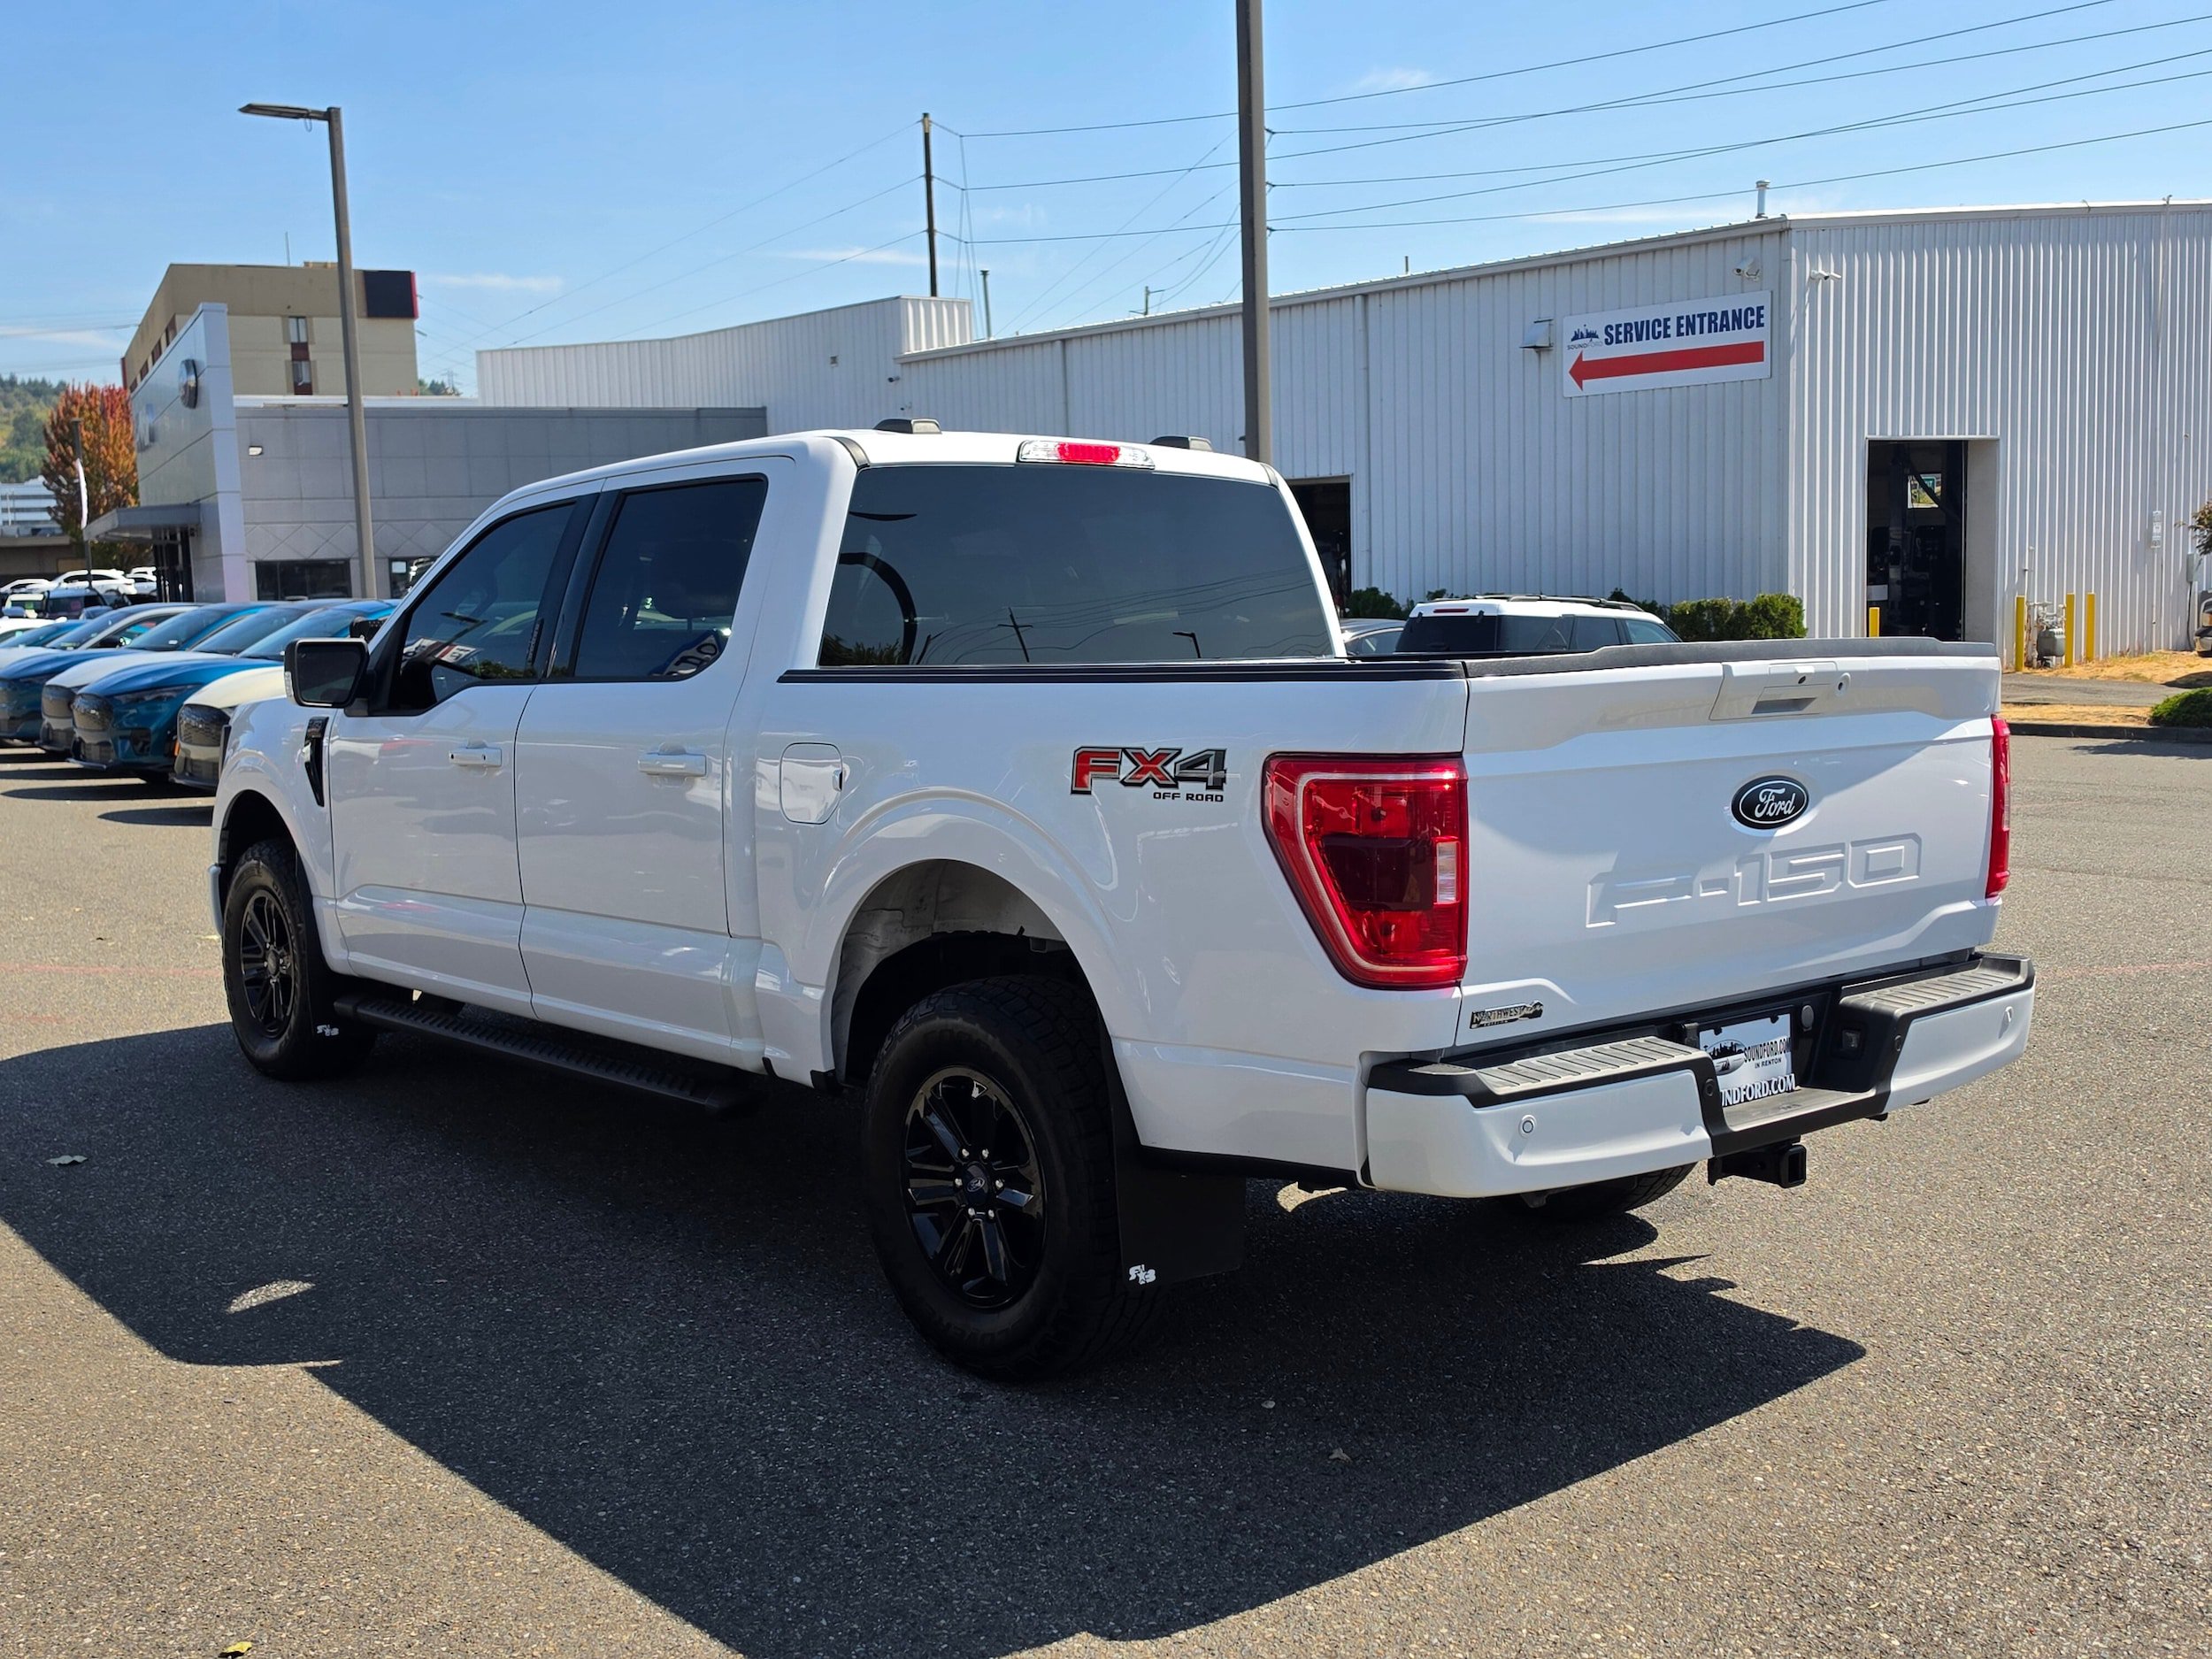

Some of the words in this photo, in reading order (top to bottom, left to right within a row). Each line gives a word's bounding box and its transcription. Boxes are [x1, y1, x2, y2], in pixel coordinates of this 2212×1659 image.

[1604, 317, 1671, 346] SERVICE
[1676, 305, 1765, 337] ENTRANCE
[1071, 746, 1227, 795] FX4
[1153, 791, 1181, 800] OFF
[1186, 793, 1224, 803] ROAD
[1755, 787, 1795, 818] Ford
[1586, 832, 1922, 927] F-150
[1762, 1057, 1782, 1067] RENTON
